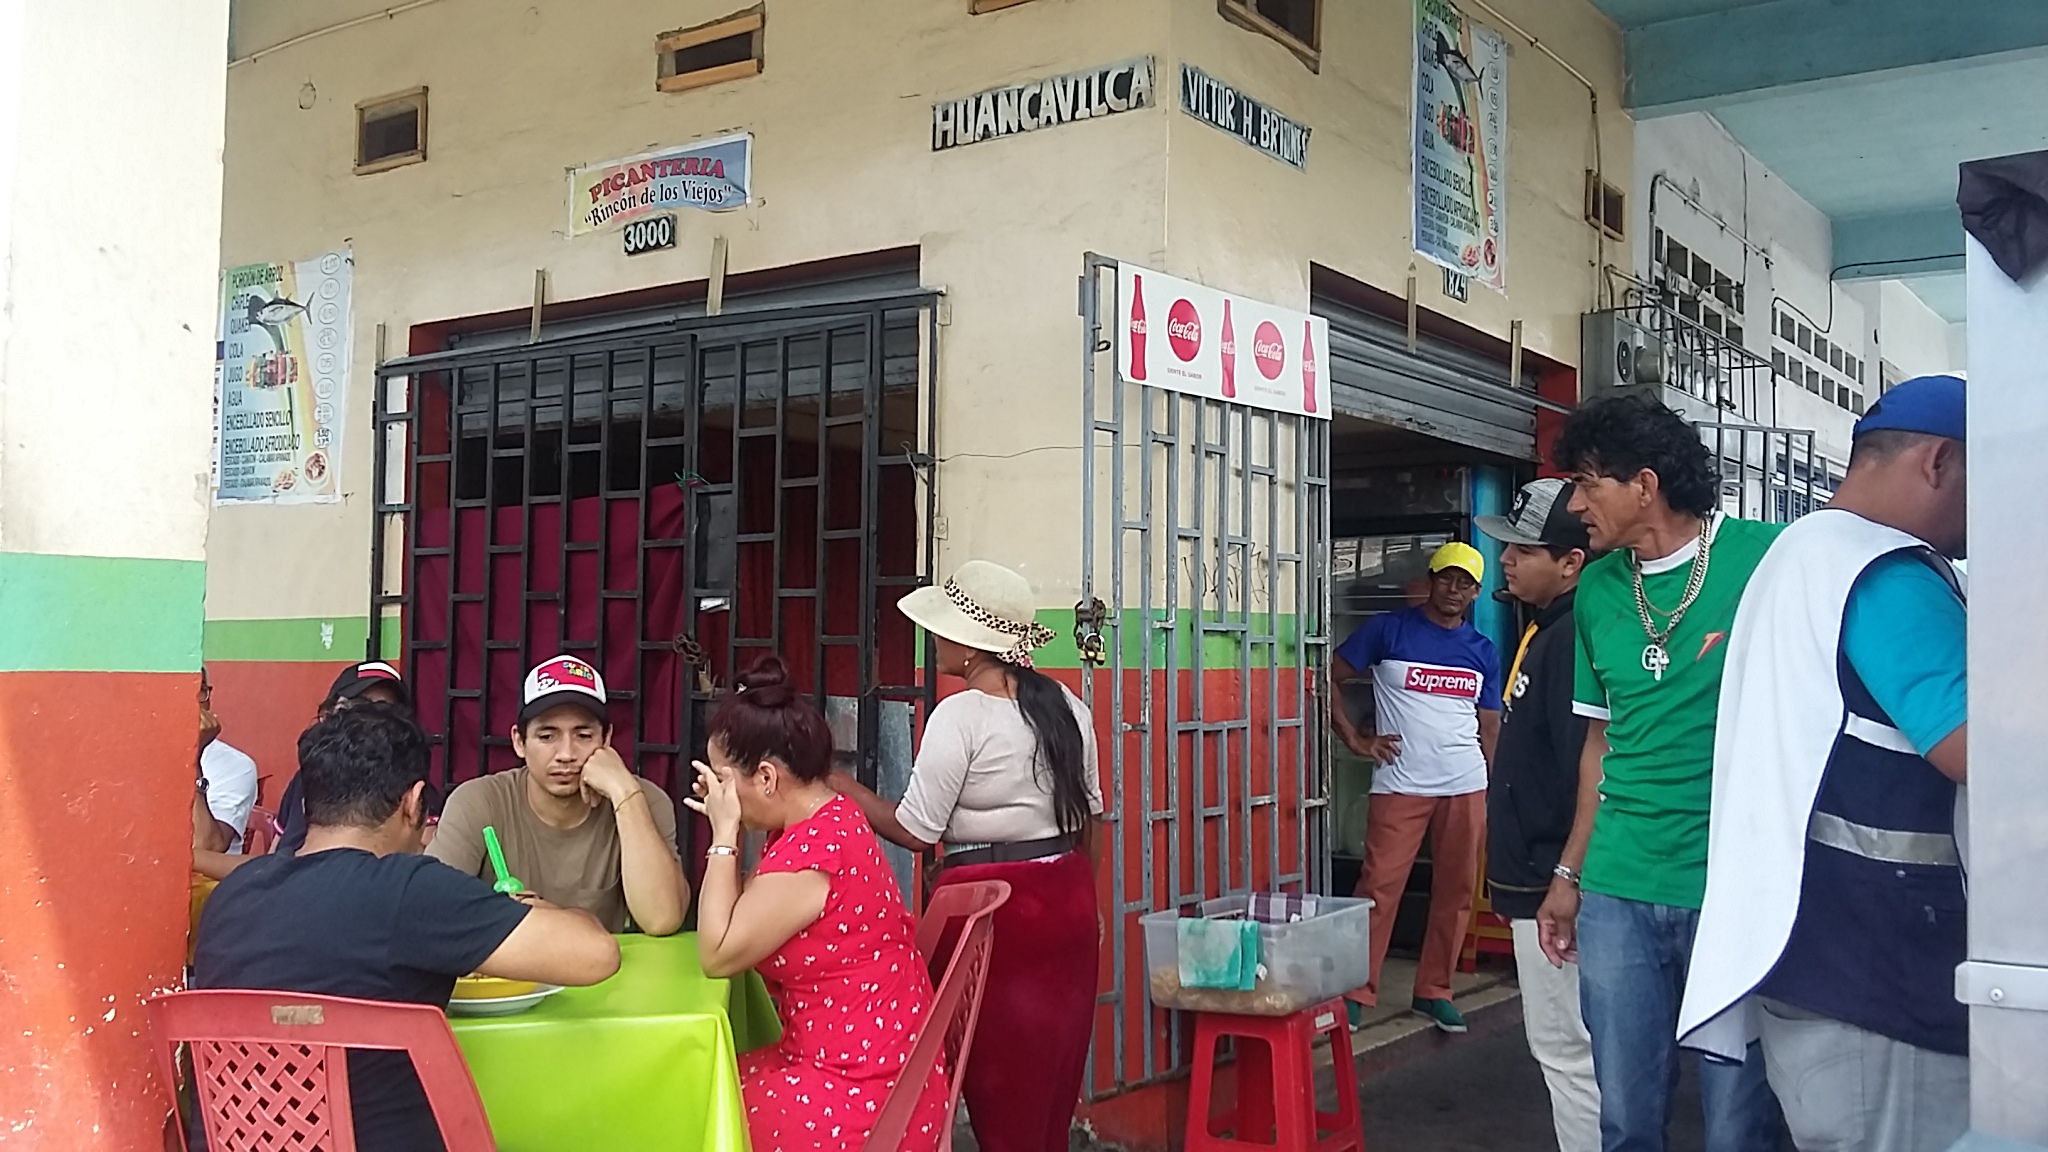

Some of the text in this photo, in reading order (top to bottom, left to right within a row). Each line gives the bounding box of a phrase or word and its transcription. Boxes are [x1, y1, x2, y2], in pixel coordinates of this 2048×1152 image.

[934, 62, 1152, 149] HUANCAVILCA
[1186, 67, 1236, 132] VICTOR
[1242, 97, 1257, 145] H.
[588, 157, 726, 204] PICANTERIA
[640, 186, 656, 206] de
[659, 182, 678, 202] los
[624, 218, 671, 252] 3000
[228, 342, 243, 359] COLA
[227, 390, 243, 407] AGUA
[226, 412, 264, 431] ENCEBOLLADO
[225, 437, 264, 455] ENCEBOLLADO
[1408, 668, 1477, 692] Supreme
